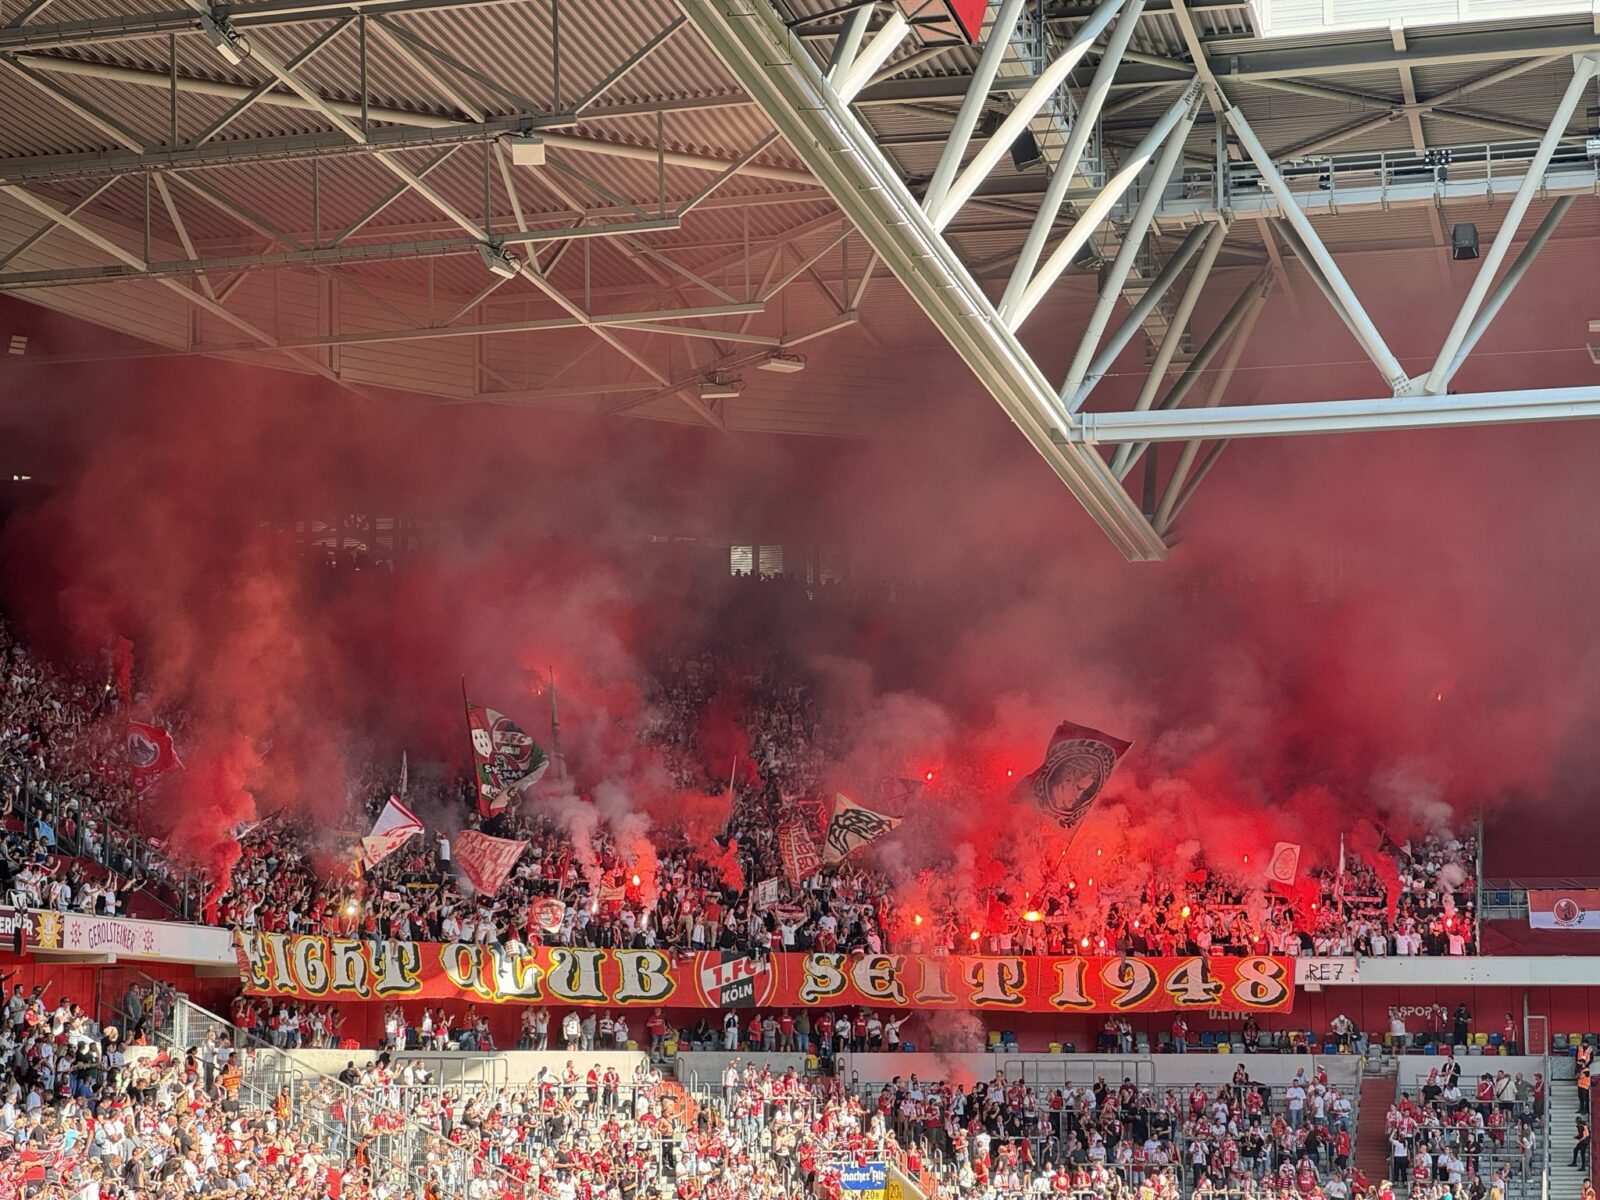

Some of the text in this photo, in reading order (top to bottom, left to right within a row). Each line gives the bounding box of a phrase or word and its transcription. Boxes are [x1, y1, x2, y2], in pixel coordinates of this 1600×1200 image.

[88, 922, 136, 951] GEROLSTEINER
[441, 943, 675, 1002] CLUB
[800, 953, 1027, 1006] SEIT
[1050, 956, 1289, 1009] 1948
[722, 984, 752, 1004] KÖLN
